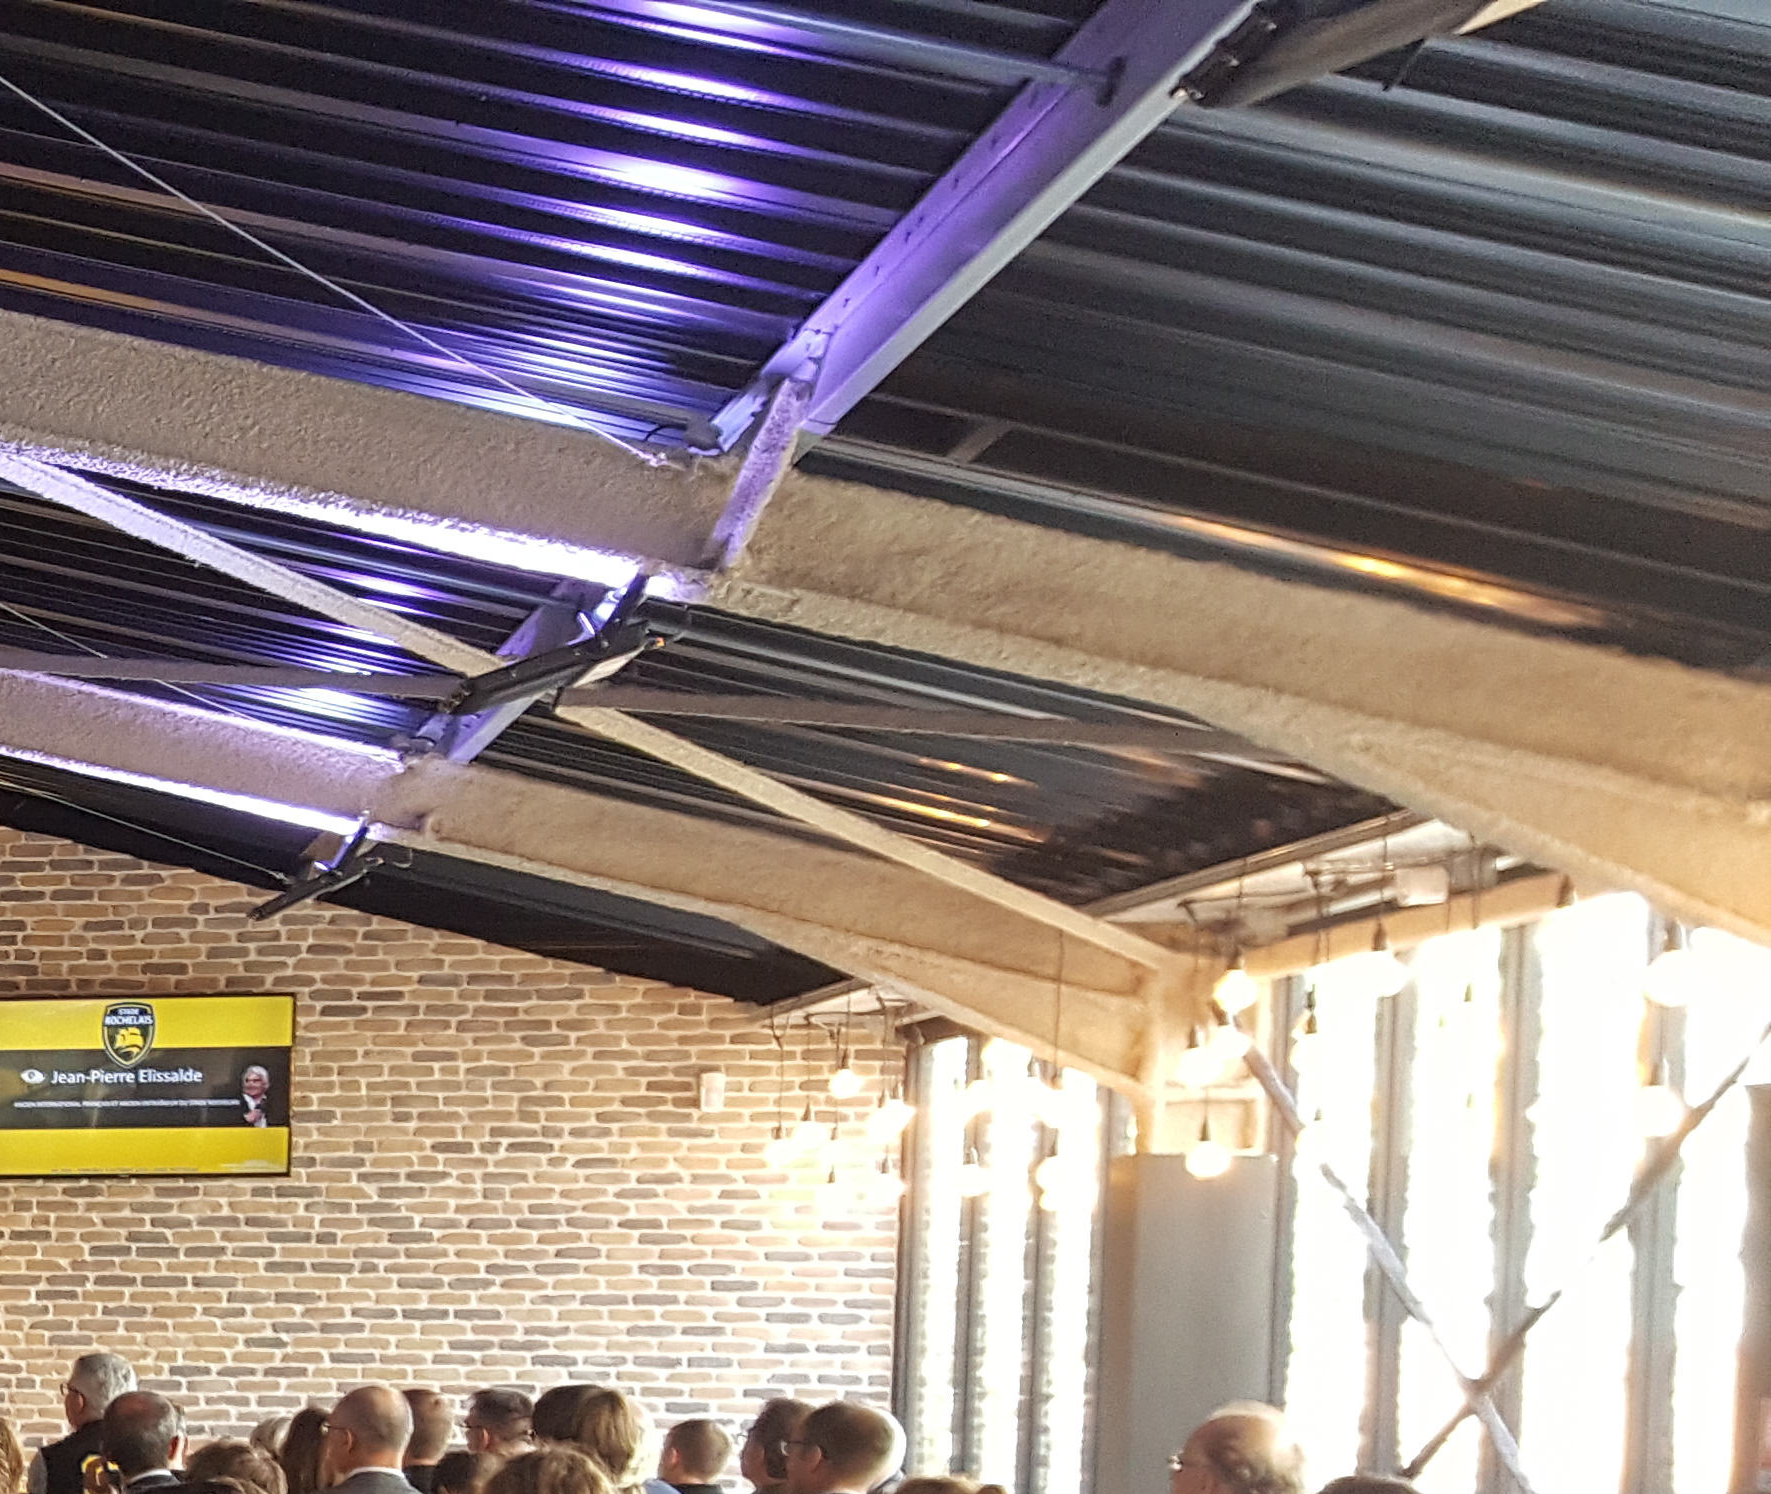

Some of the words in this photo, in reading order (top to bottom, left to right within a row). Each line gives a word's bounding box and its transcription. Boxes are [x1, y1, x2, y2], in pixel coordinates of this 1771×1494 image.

[104, 1015, 153, 1025] ROCHELAIS
[51, 1069, 135, 1084] Jean-Pierre
[138, 1068, 203, 1083] Elissalde
